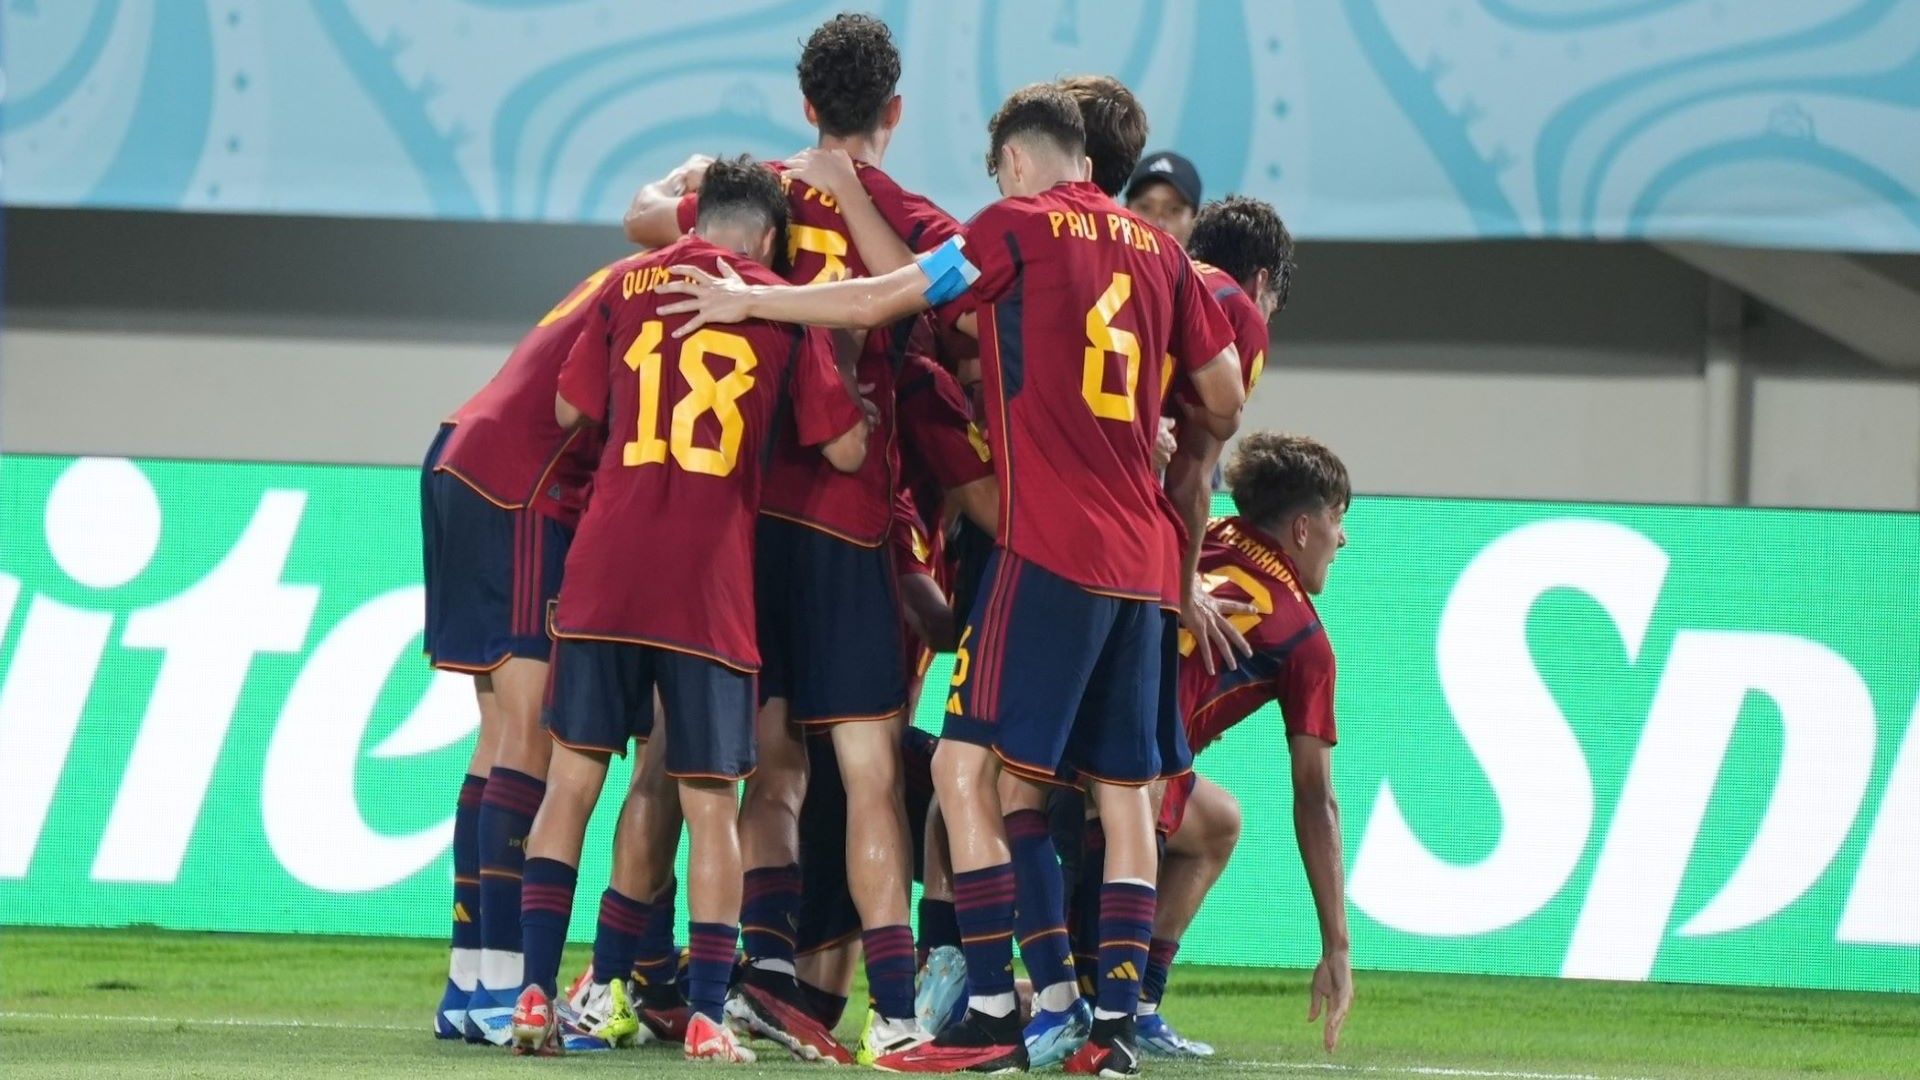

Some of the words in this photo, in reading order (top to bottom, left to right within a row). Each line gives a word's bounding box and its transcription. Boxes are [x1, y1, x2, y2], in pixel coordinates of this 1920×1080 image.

[622, 264, 672, 300] QUIM
[1047, 211, 1098, 241] PAU
[1106, 213, 1161, 255] PRIM
[623, 320, 759, 478] 18
[1082, 272, 1141, 422] 6
[0, 457, 482, 894] ite
